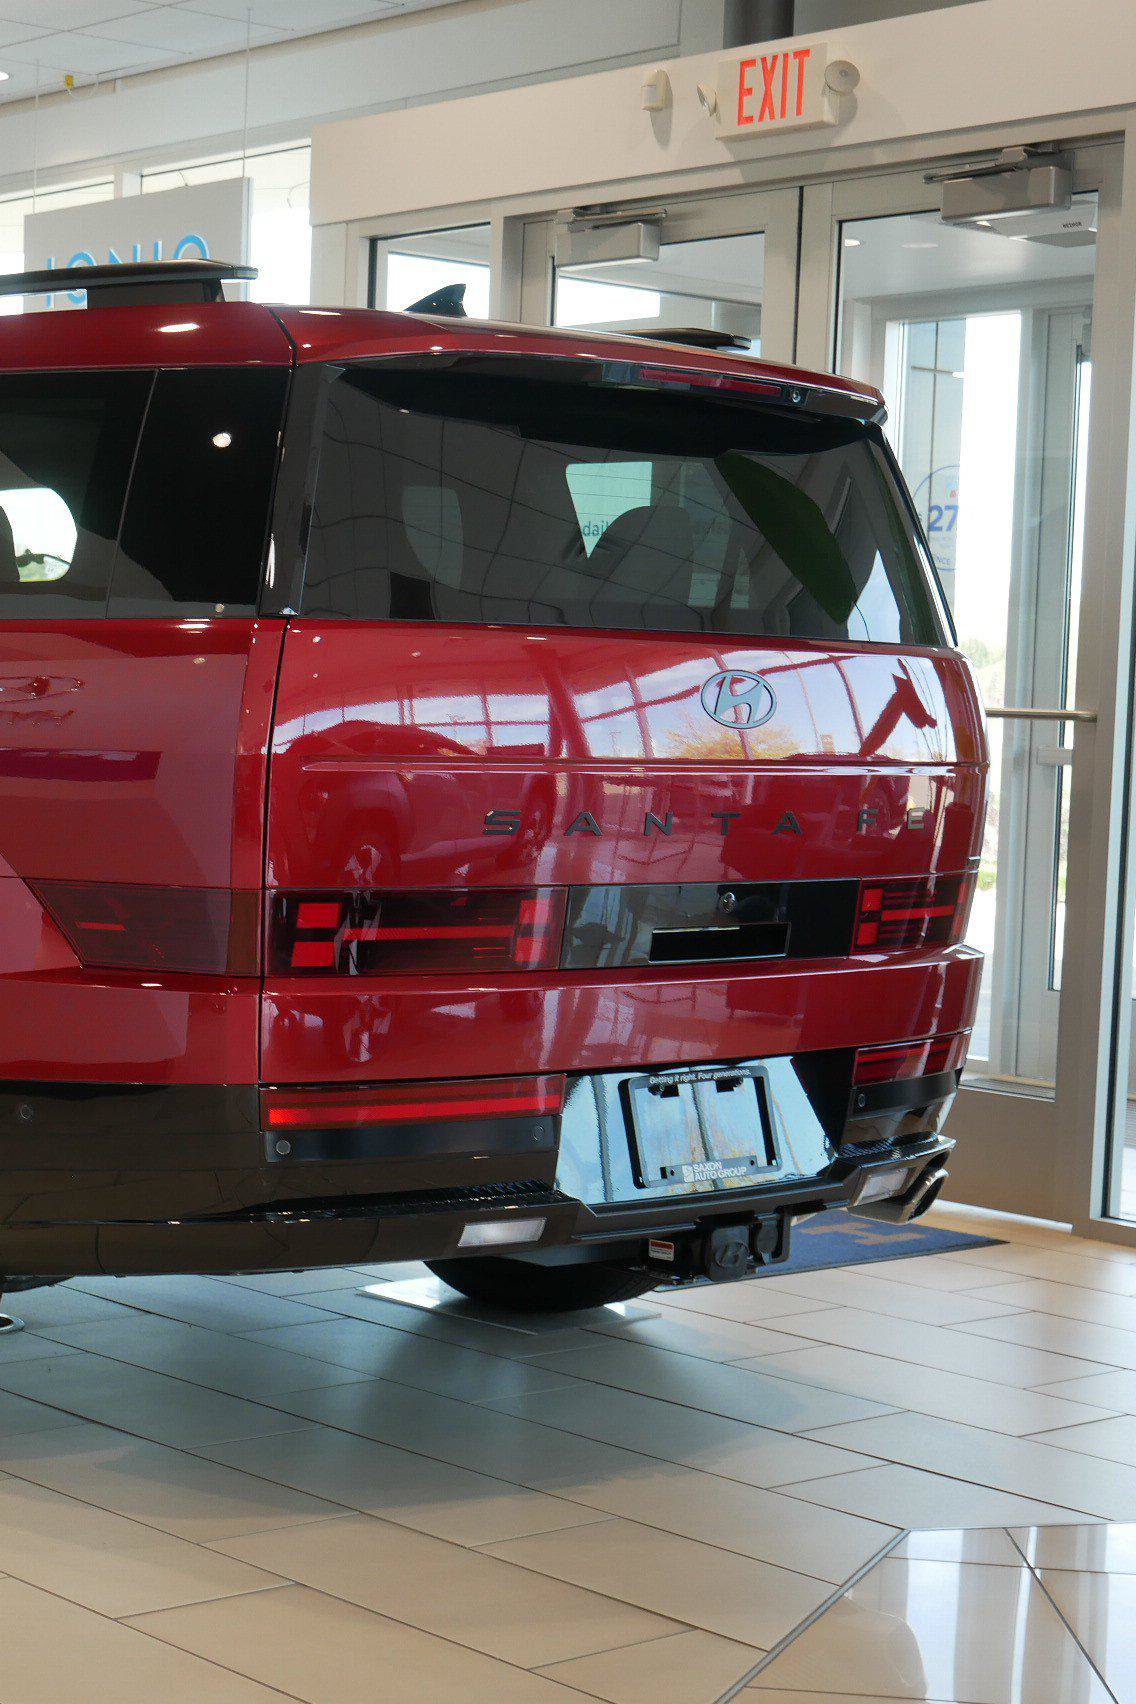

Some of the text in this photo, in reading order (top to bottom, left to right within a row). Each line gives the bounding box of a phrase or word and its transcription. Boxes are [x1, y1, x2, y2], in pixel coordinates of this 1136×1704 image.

[738, 49, 812, 126] EXIT
[928, 505, 959, 532] 27
[481, 806, 926, 837] SANTA FE
[649, 1074, 674, 1085] Getting
[697, 1072, 712, 1081] Four
[693, 1160, 722, 1172] SAXON
[694, 1165, 747, 1182] AUTO GROUP
